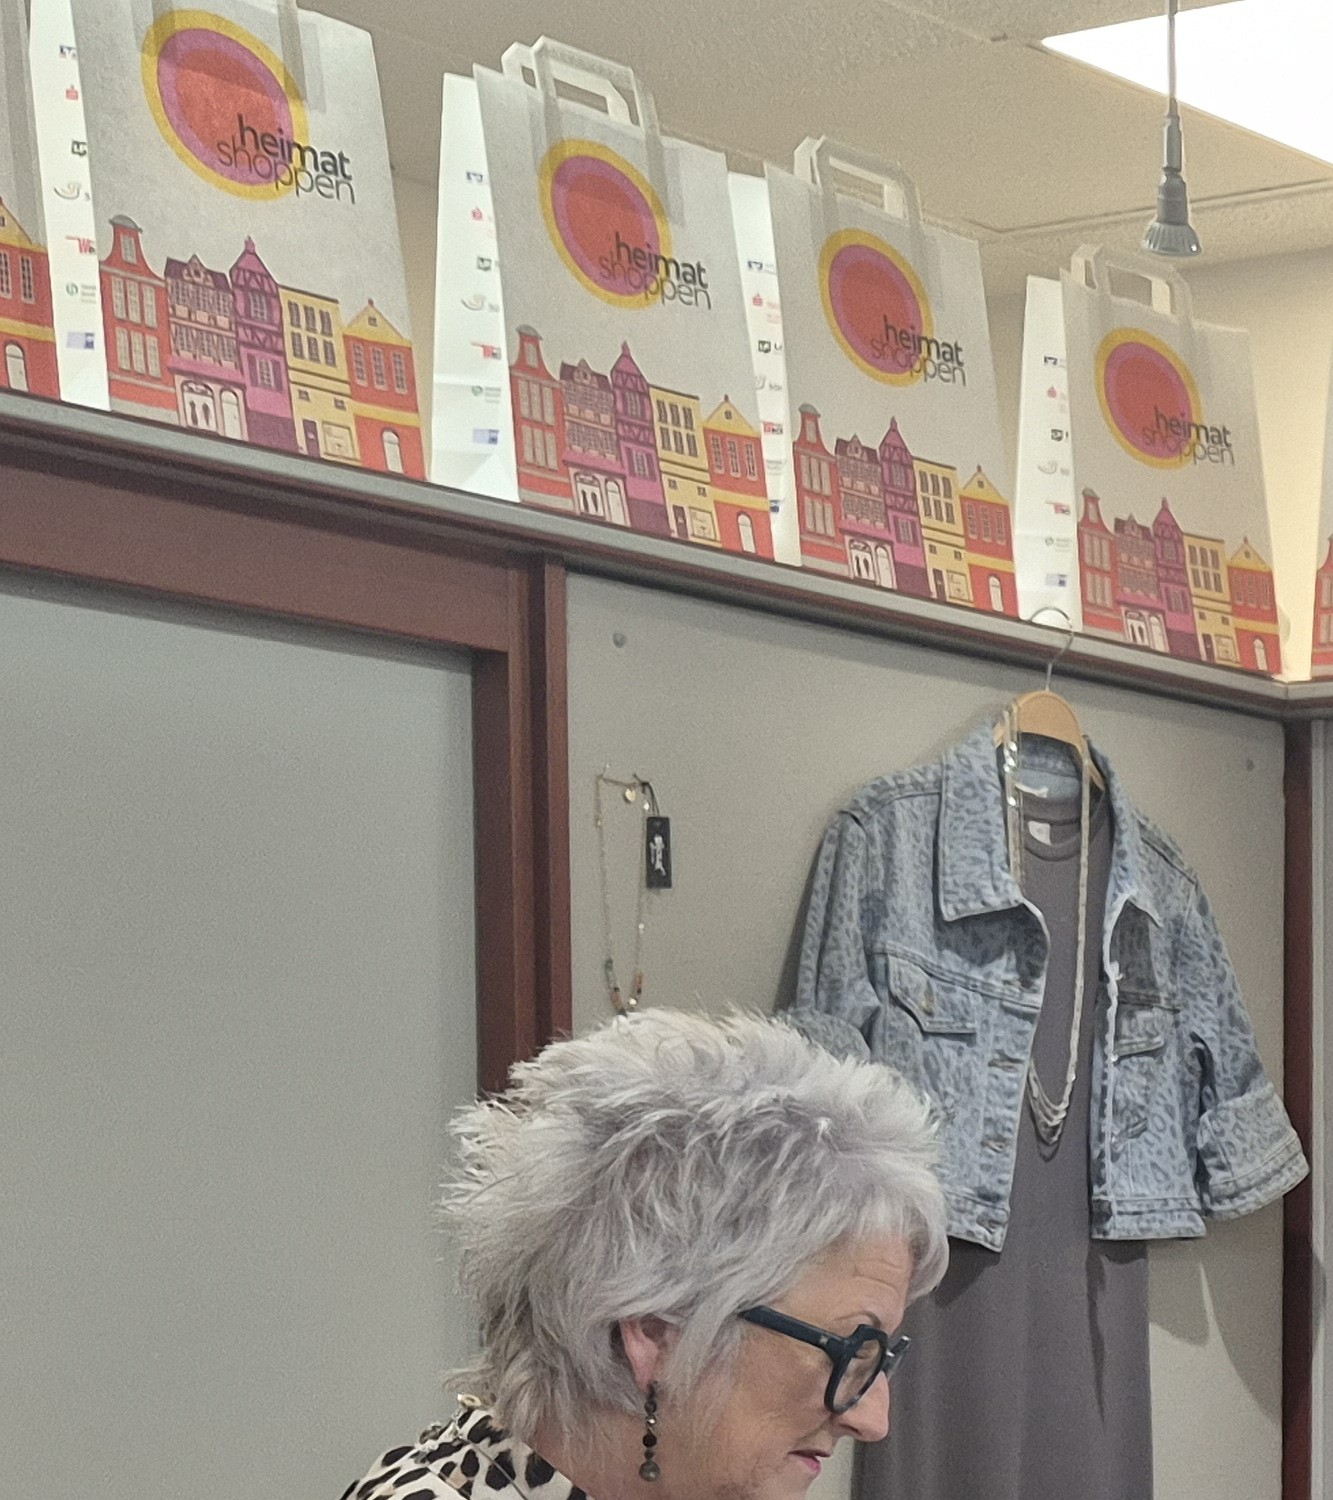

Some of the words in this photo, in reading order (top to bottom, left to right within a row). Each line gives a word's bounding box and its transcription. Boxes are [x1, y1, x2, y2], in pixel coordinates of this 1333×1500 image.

[217, 135, 355, 204] shoppen
[237, 113, 352, 180] heimat
[599, 251, 711, 310] shoppen
[615, 231, 708, 289] heimat
[870, 336, 966, 387] shoppen
[884, 315, 964, 367] heimat
[1143, 426, 1234, 466] shoppen
[1154, 405, 1231, 447] heimat
